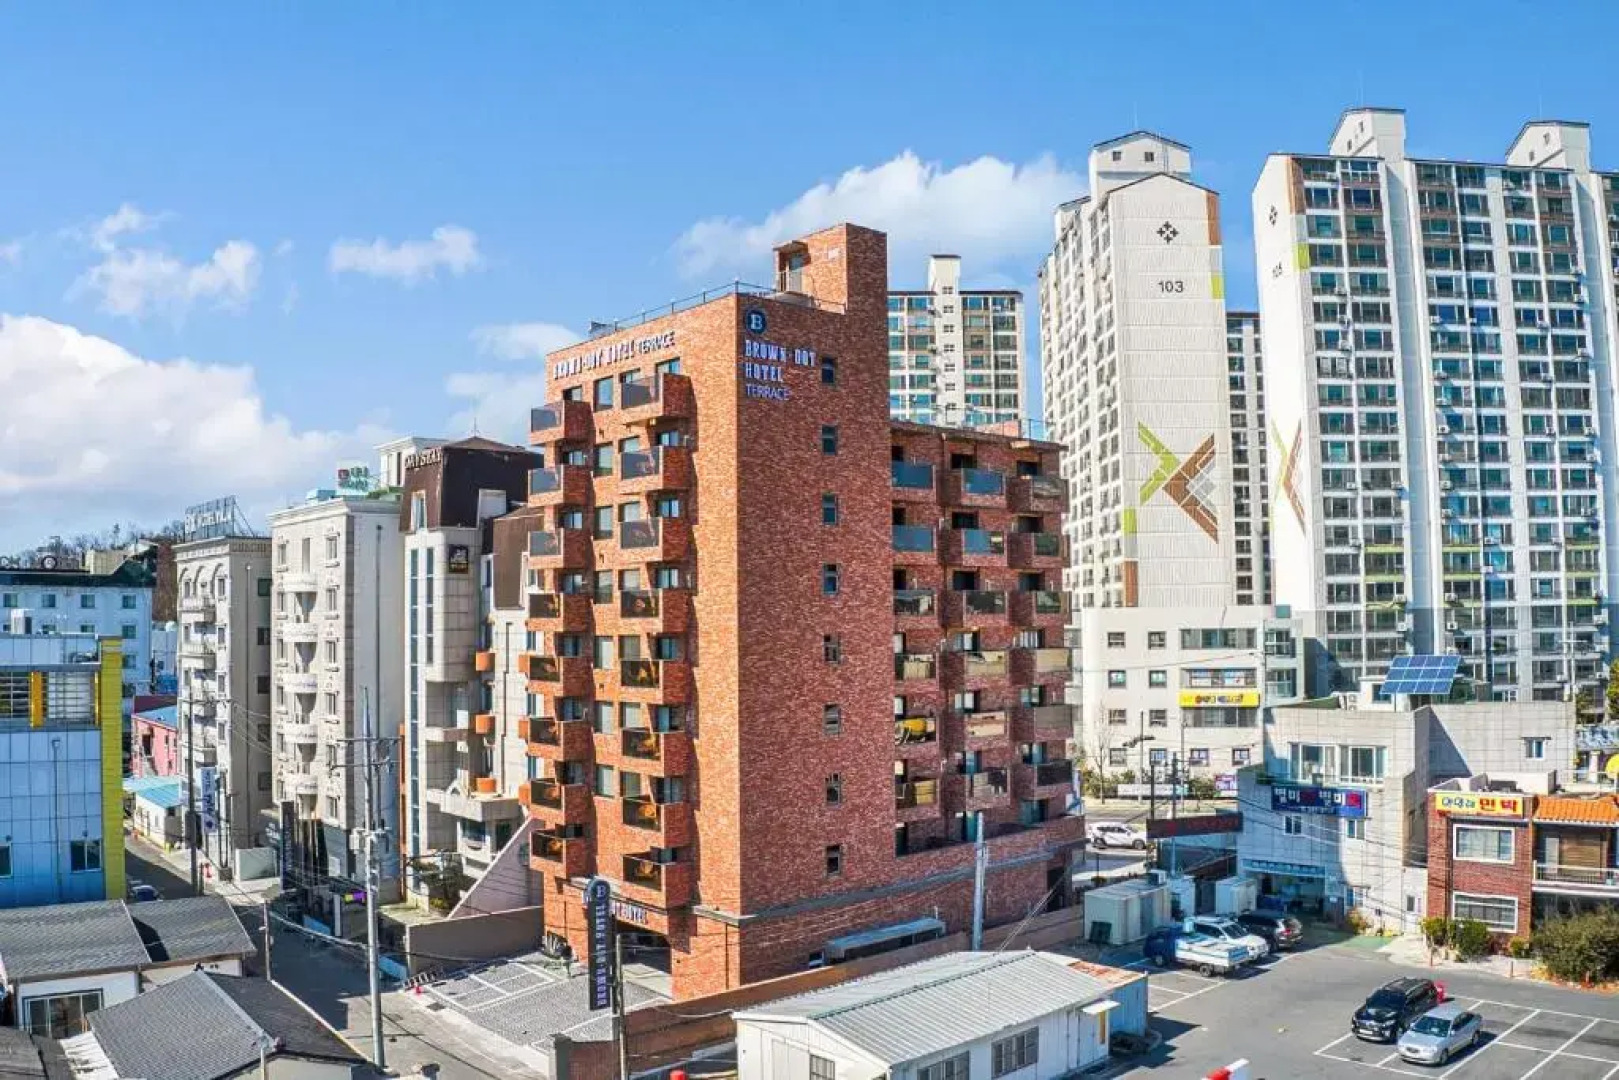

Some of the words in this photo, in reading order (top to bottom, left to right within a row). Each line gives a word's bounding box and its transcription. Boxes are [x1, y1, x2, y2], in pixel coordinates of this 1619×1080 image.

[1158, 280, 1184, 293] 103
[750, 313, 764, 330] B
[637, 332, 675, 354] TERRACE
[745, 362, 784, 382] HOTEL
[745, 383, 791, 401] TERRACE
